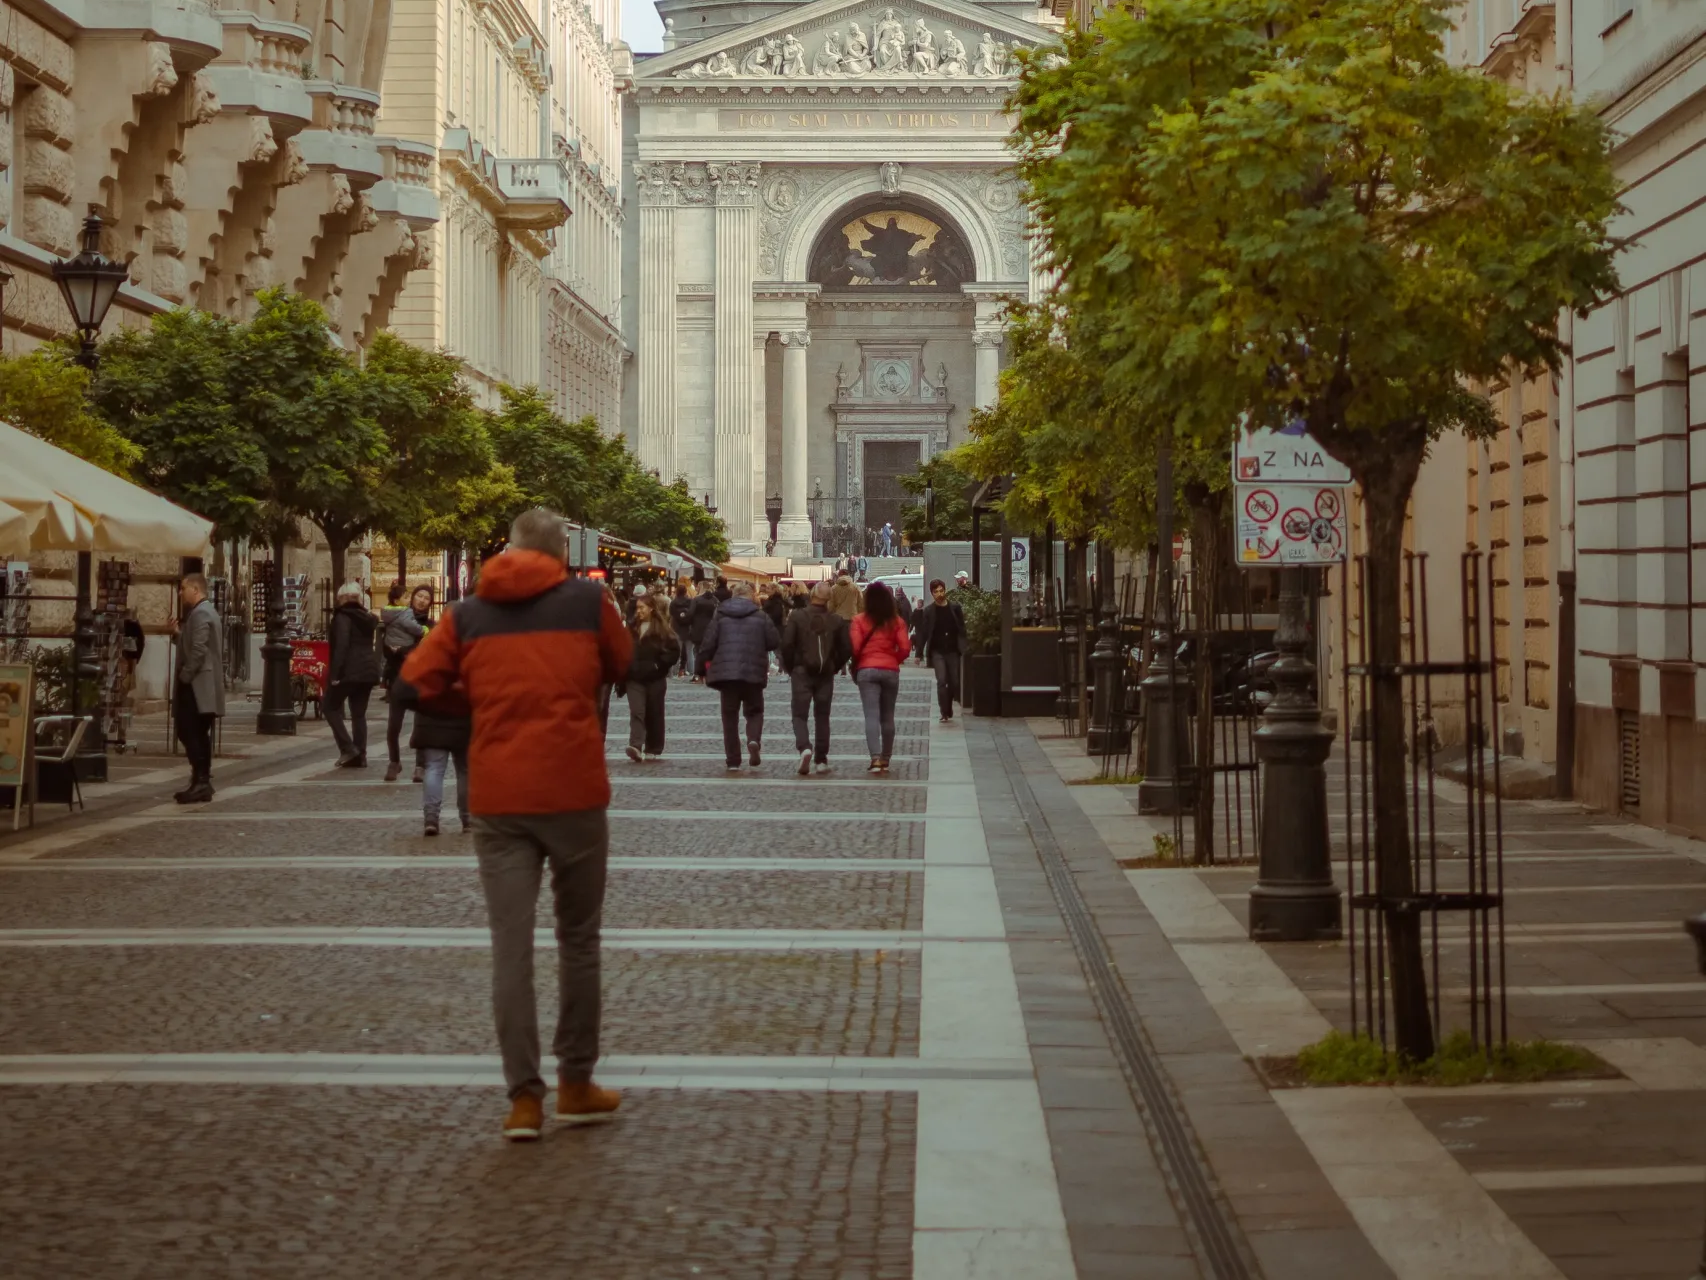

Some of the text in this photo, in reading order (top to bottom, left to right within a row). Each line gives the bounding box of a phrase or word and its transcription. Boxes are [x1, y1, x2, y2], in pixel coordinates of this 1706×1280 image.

[738, 113, 775, 127] EGO
[788, 113, 828, 127] SUM
[843, 113, 872, 127] VIA
[885, 113, 959, 127] VERITAS
[971, 113, 994, 127] ET
